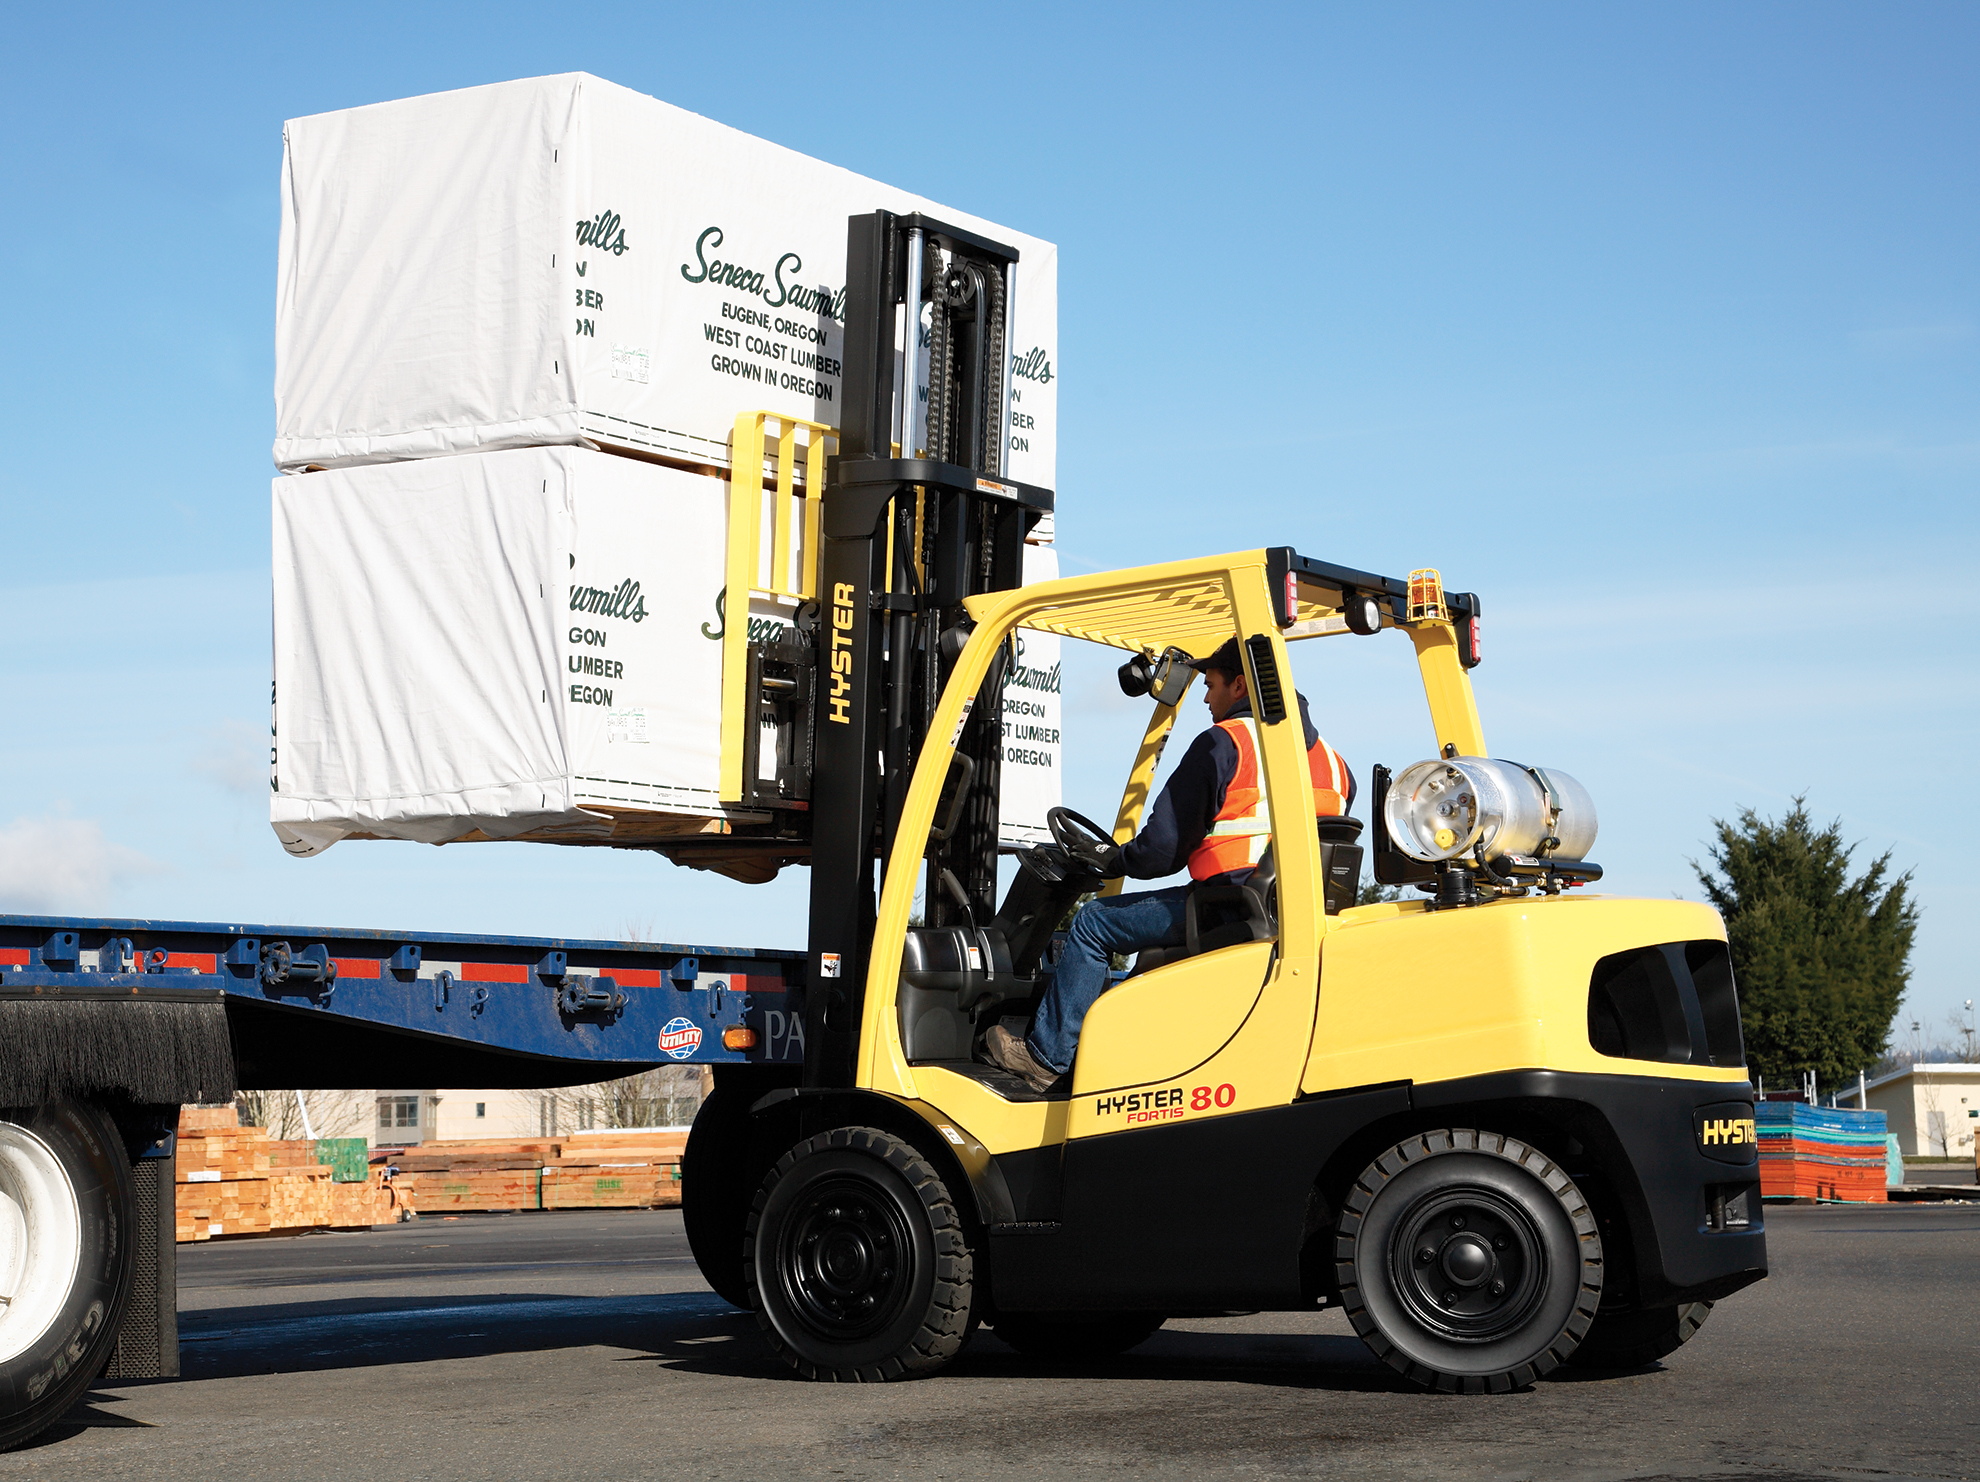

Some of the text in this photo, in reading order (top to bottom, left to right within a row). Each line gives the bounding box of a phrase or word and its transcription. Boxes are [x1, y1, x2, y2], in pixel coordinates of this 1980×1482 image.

[681, 226, 765, 297] Seneca
[721, 301, 828, 346] EUGENE, OREGON
[703, 322, 842, 378] WEST COAST LUMBER
[711, 354, 833, 402] GROWN IN OREGON
[1010, 411, 1035, 431] BER
[569, 577, 650, 624] wmills
[829, 582, 855, 724] HYSTER
[569, 685, 613, 707] EGON
[1002, 699, 1046, 718] OREGON
[1015, 724, 1061, 744] LUMBER
[1007, 747, 1052, 768] OREGON
[661, 1030, 701, 1048] UTILITY
[1097, 1088, 1184, 1116] HYSTER
[1190, 1083, 1237, 1111] 80
[1127, 1107, 1184, 1124] FORTIS
